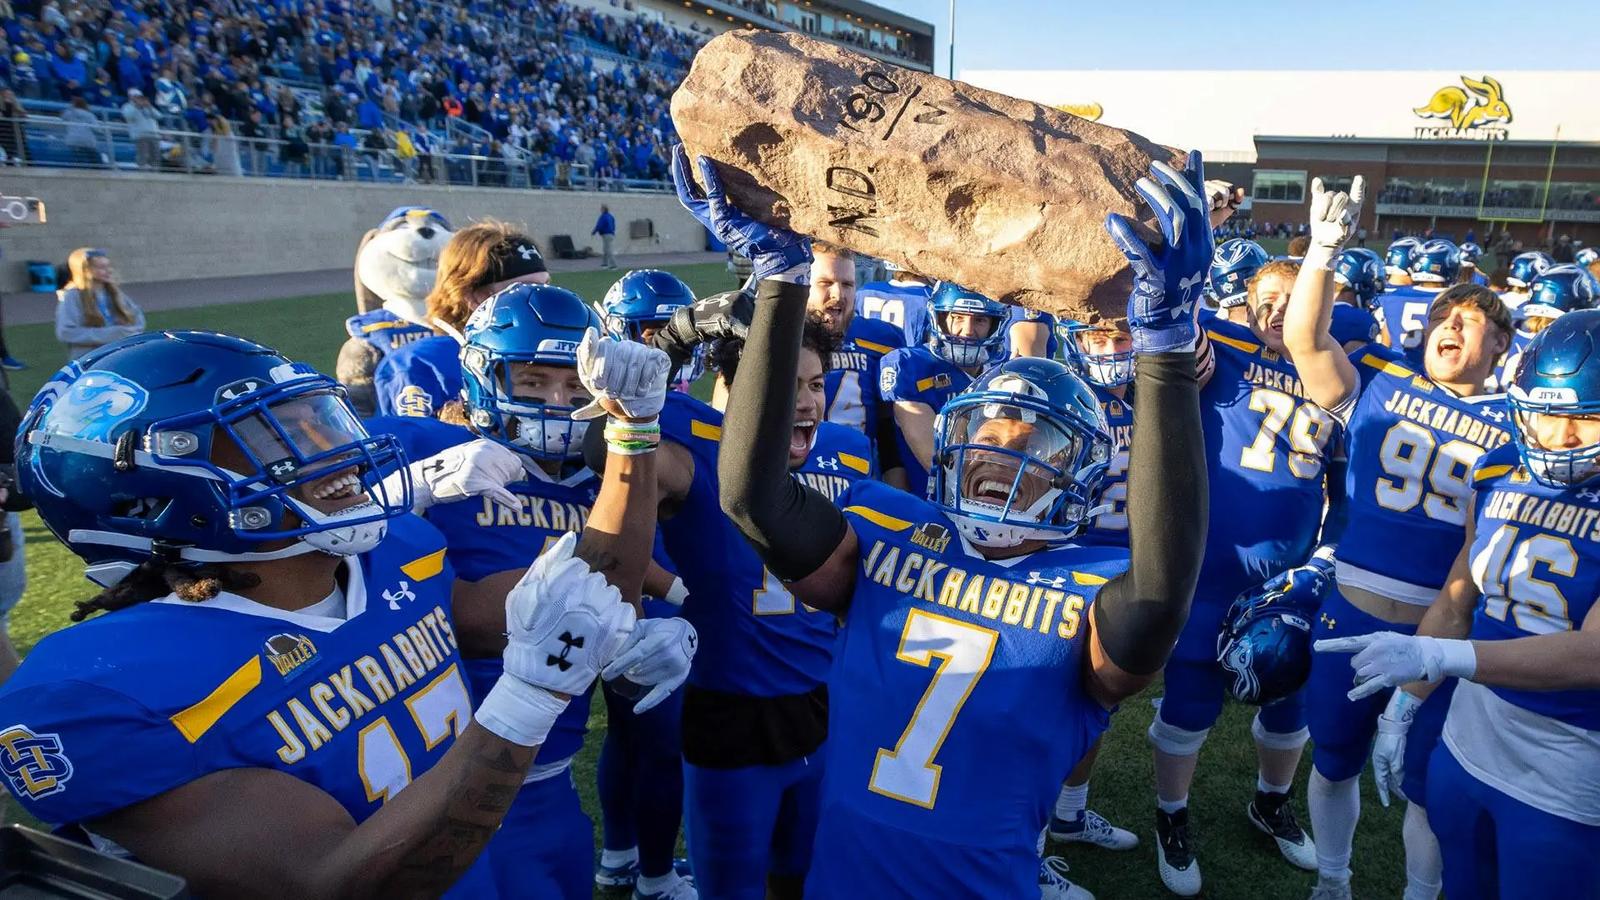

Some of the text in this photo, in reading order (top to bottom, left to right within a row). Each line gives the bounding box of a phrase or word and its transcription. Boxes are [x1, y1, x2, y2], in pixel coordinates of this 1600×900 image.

[1415, 127, 1508, 141] JACKRABBITS
[554, 341, 579, 351] JFP
[1243, 362, 1312, 401] JACKRA
[1240, 386, 1335, 480] 79
[1384, 390, 1511, 449] JACKRABBITS
[1376, 420, 1484, 527] 99
[910, 526, 951, 554] VALLEY
[1471, 523, 1579, 635] 16
[862, 540, 1085, 640] JACKRABBITS
[265, 605, 458, 766] JACKRABBITS
[266, 634, 318, 676] VALLEY
[357, 662, 473, 804] 17
[868, 606, 999, 810] 7
